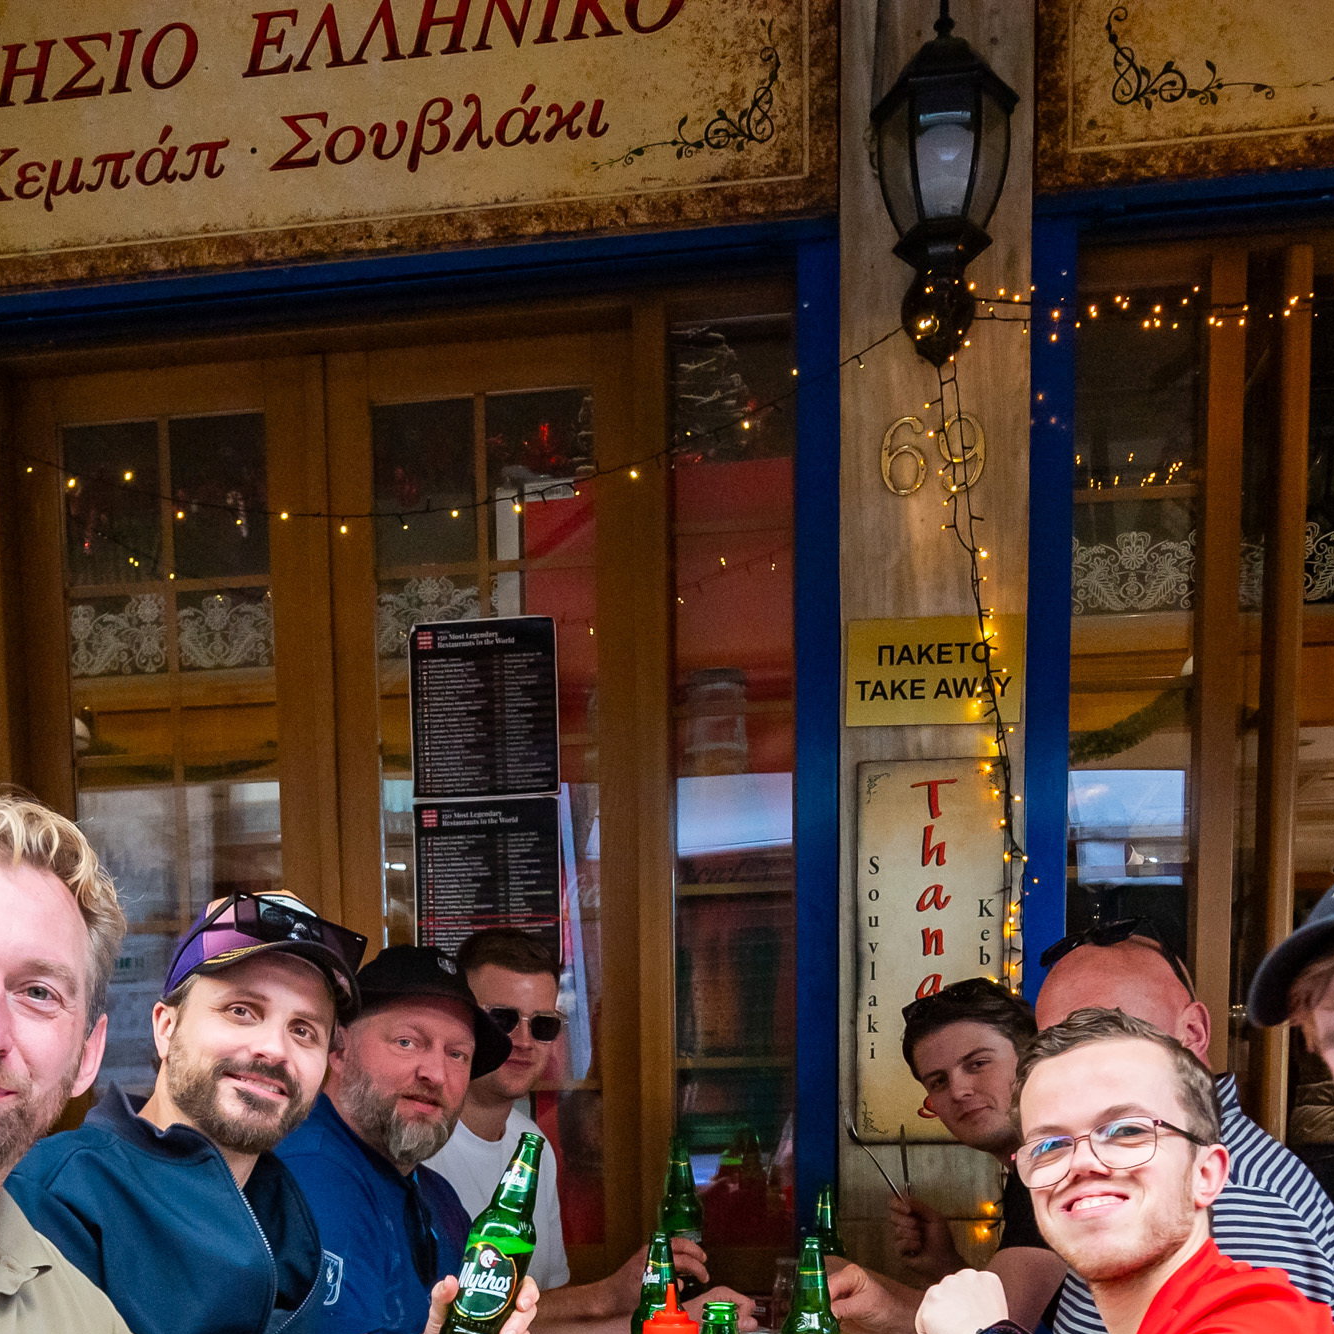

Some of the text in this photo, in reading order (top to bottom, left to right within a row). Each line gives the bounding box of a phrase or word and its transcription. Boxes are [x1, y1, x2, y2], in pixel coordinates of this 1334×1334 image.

[269, 83, 609, 176] Σουβλάκι
[880, 413, 987, 496] 69
[437, 640, 475, 649] Restaurants
[483, 638, 494, 646] the
[495, 637, 515, 645] World
[466, 631, 499, 640] Legendary
[877, 641, 991, 667] ΠΑΚΕΤΟ
[855, 675, 1013, 702] TAKE AWAY
[442, 819, 479, 827] Restaurants
[499, 816, 518, 824] World
[453, 811, 469, 819] Most
[469, 810, 502, 819] Legendary
[977, 898, 995, 966] Keb
[867, 855, 881, 1060] Souvlaki
[458, 1262, 513, 1298] Mythos
